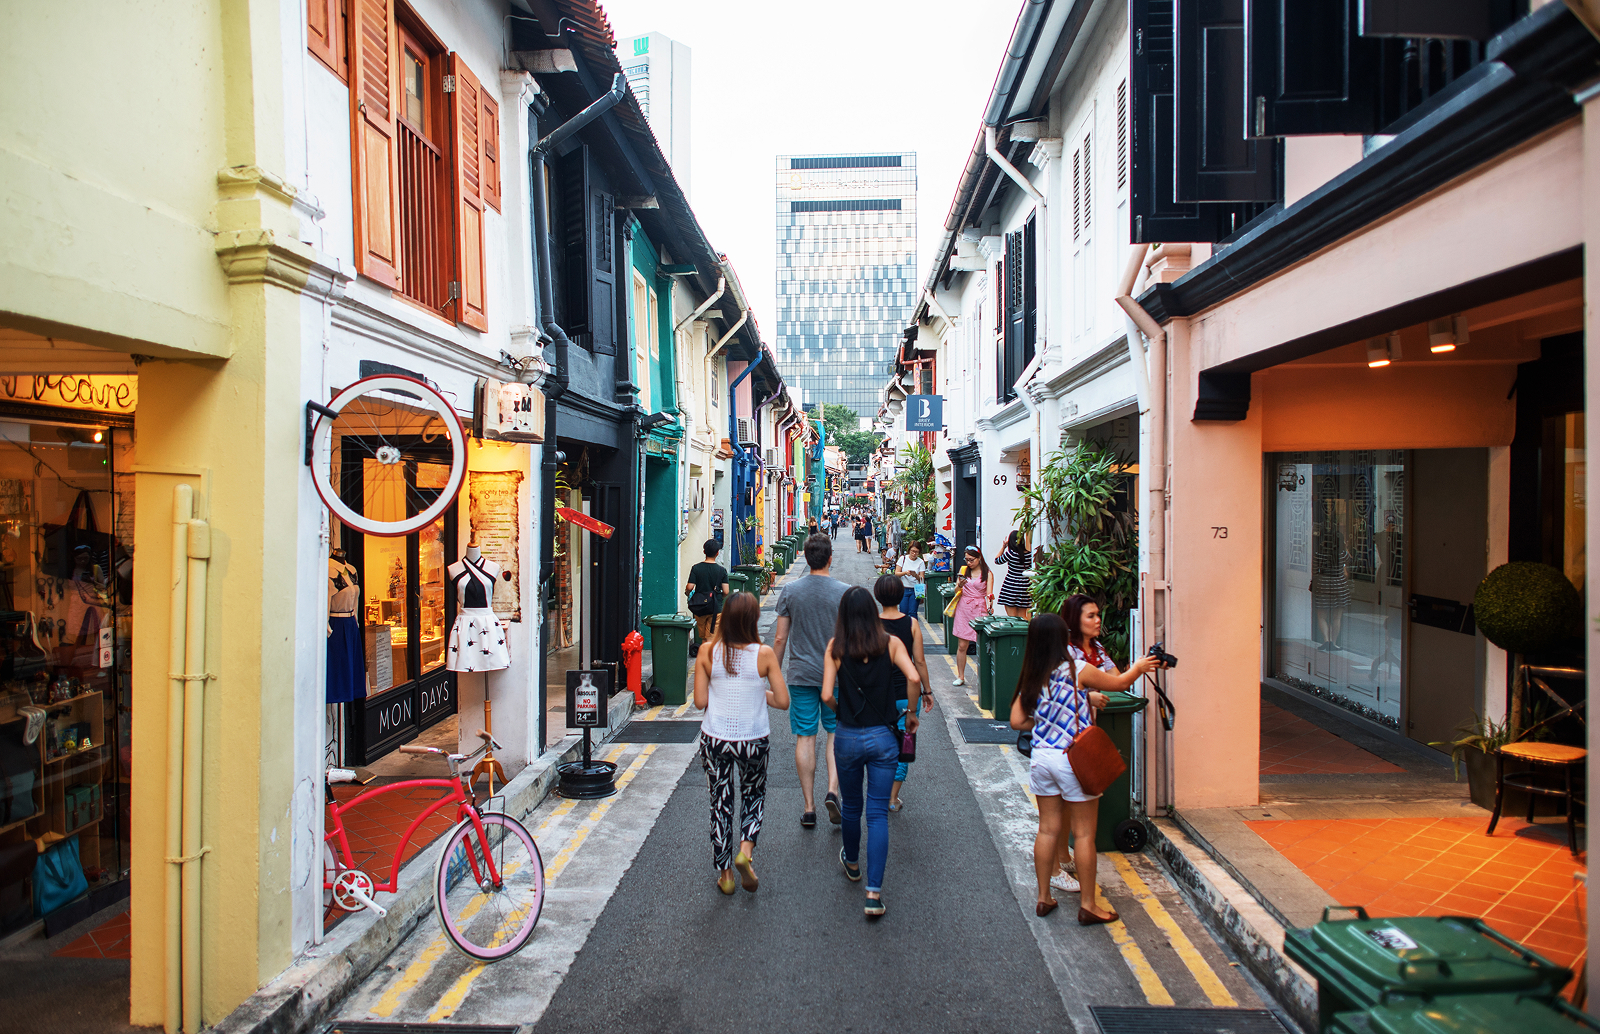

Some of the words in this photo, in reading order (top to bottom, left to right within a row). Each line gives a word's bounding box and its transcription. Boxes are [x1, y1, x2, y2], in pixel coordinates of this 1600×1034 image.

[918, 398, 931, 418] B
[993, 474, 1008, 486] 69
[479, 489, 498, 500] eighty
[498, 489, 509, 497] two
[1211, 526, 1228, 539] 73
[379, 697, 412, 734] MON
[421, 680, 449, 713] DAYS
